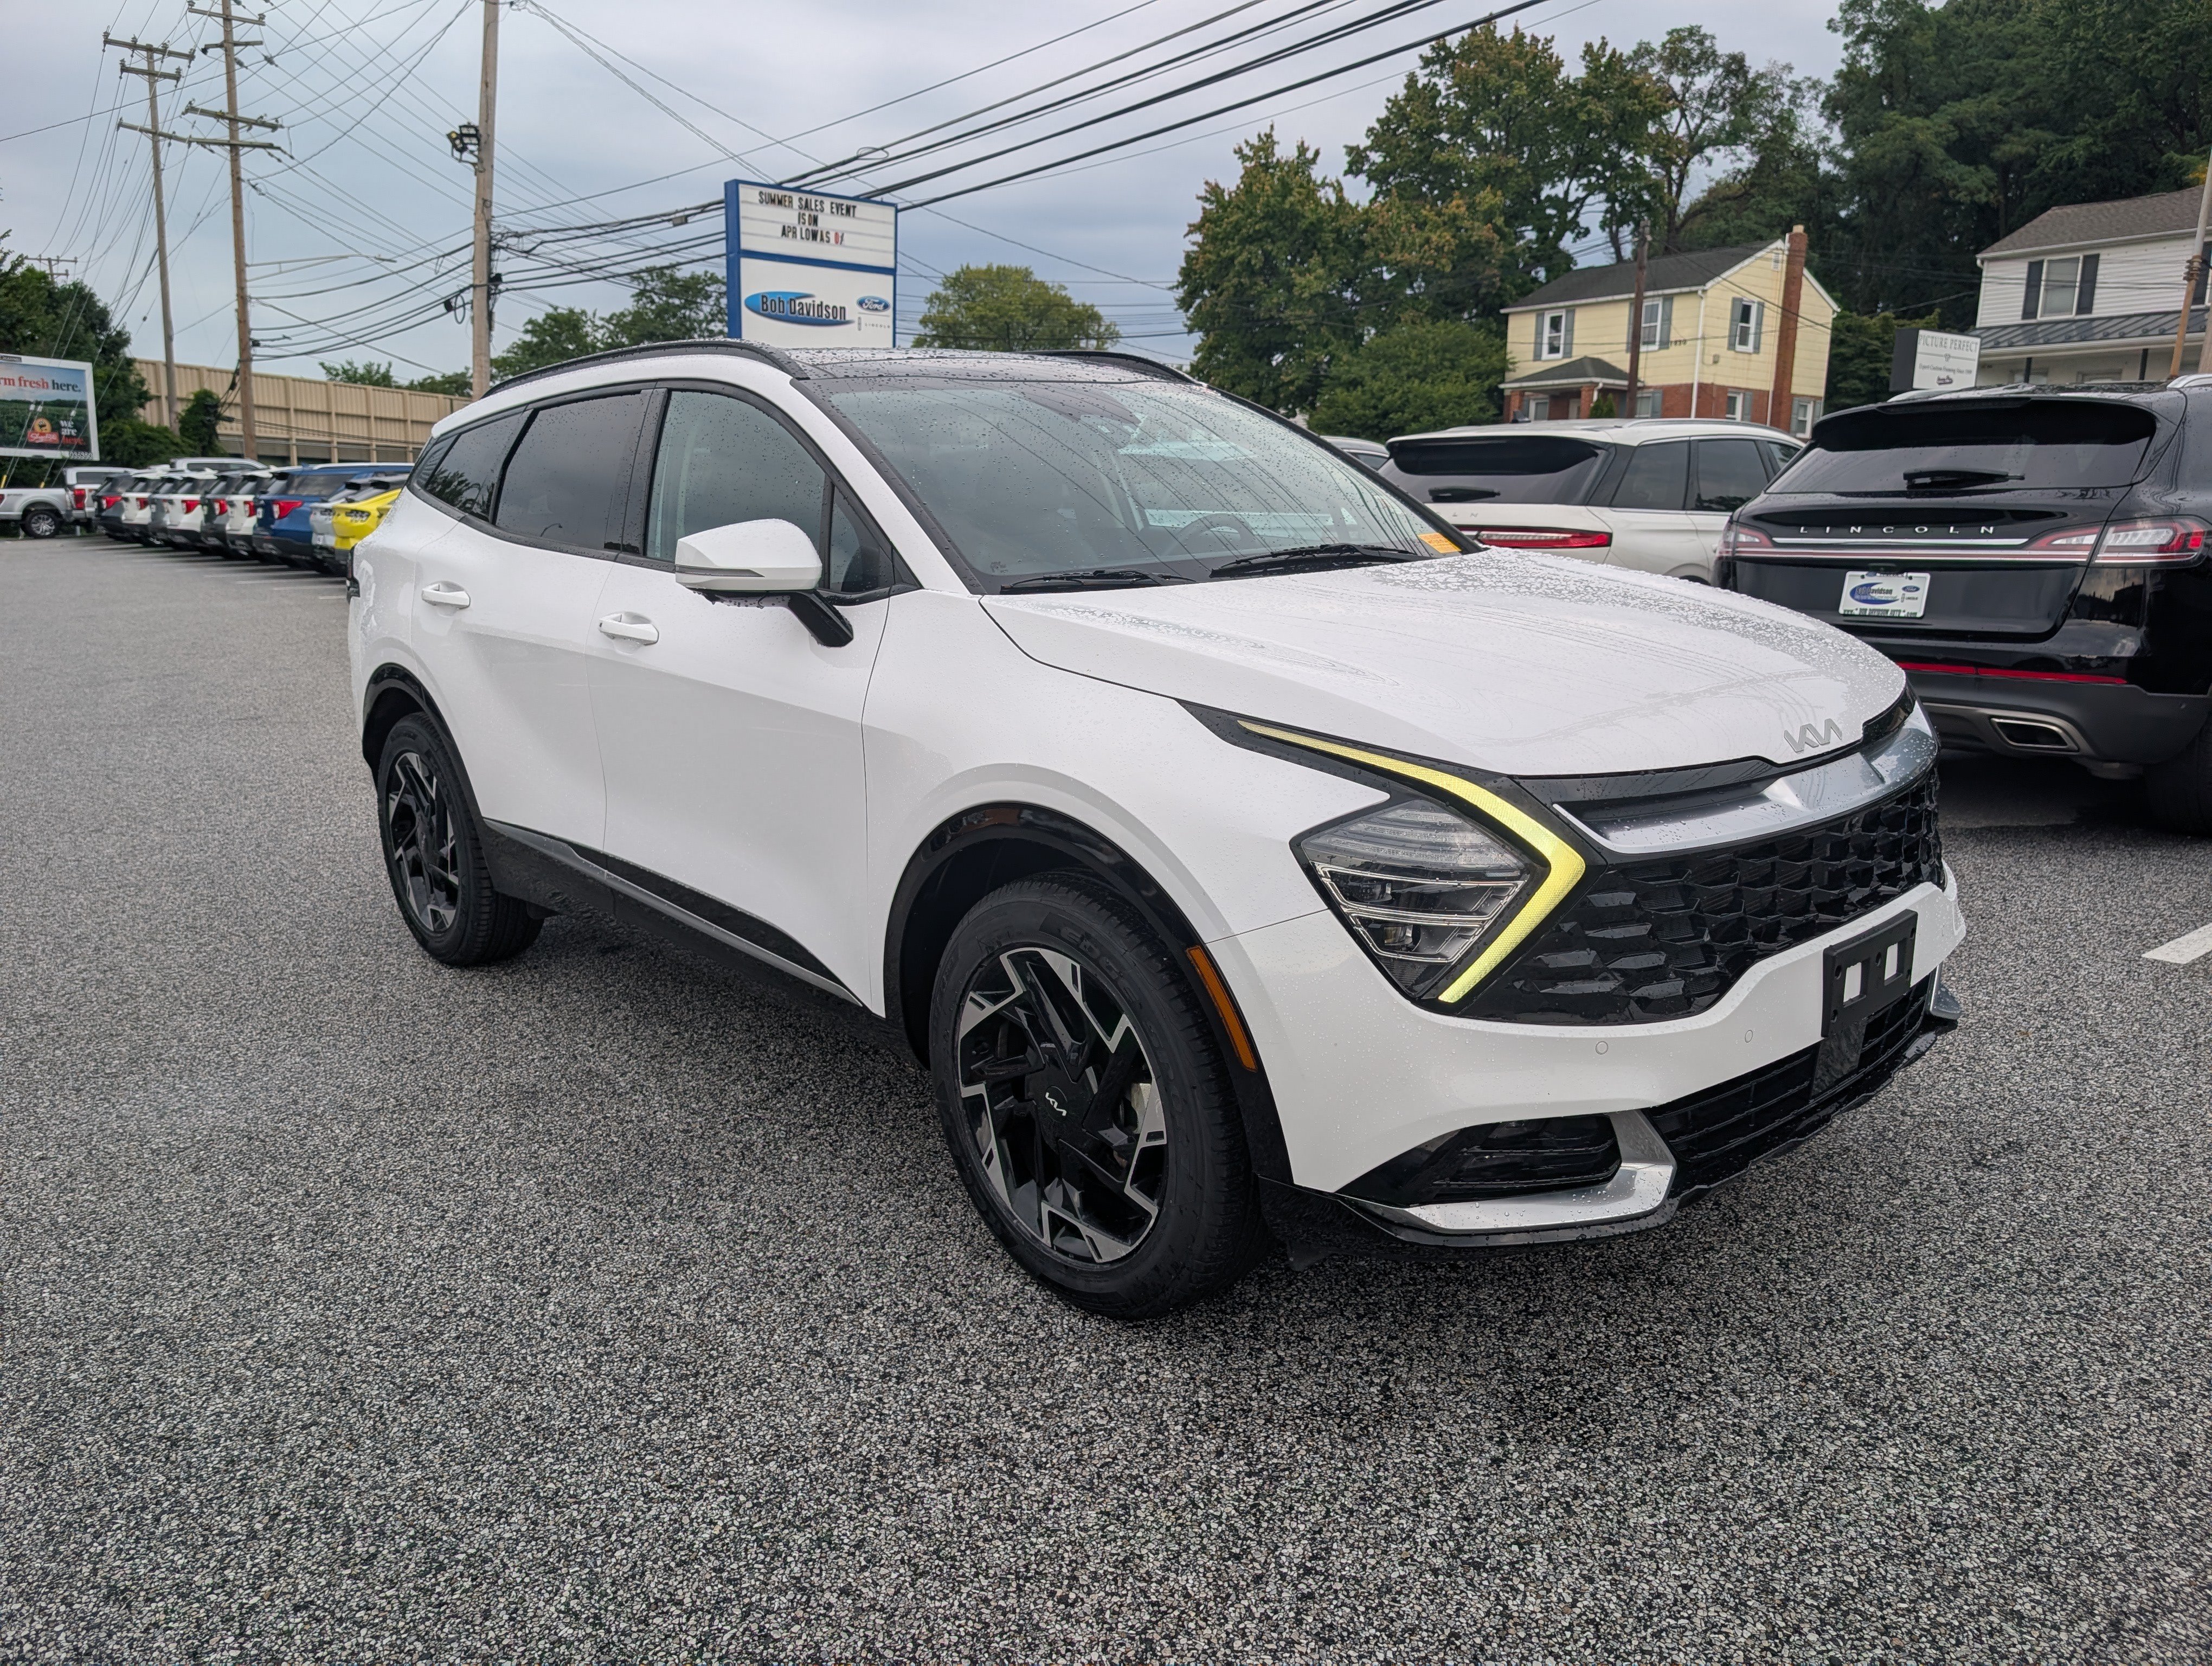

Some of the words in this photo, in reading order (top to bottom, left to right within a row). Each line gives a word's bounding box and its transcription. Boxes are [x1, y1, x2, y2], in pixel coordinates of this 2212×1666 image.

[758, 191, 793, 209] SUMMER
[798, 197, 825, 213] SALES
[830, 201, 857, 217] EVENT
[781, 225, 797, 239] APR
[761, 294, 785, 314] Bob
[789, 298, 846, 321] Davidson
[861, 297, 886, 311] Ford
[1918, 334, 1948, 349] PICTURE
[1950, 338, 1978, 353] PERFECT
[18, 375, 49, 389] fresh
[52, 379, 81, 392] here.
[1799, 526, 1995, 534] LINCOLN
